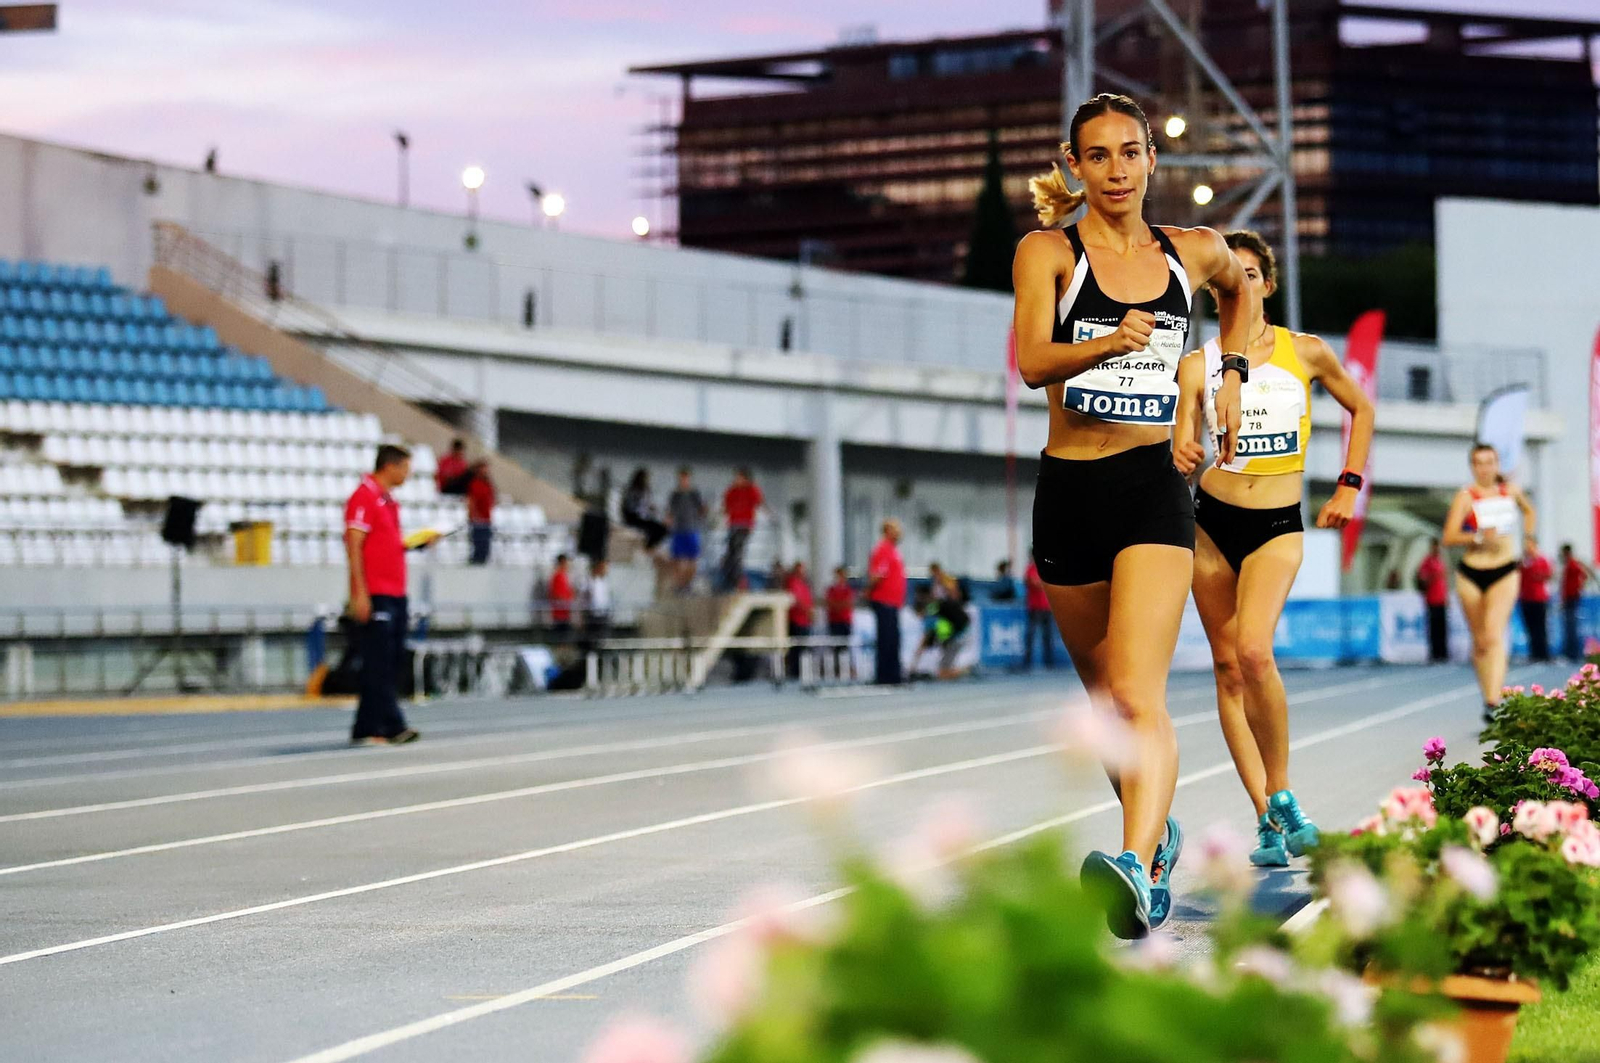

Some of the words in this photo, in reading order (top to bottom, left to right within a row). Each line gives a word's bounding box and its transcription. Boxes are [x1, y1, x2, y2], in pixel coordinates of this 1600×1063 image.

[1091, 360, 1166, 372] ARCÍA-CARO
[1118, 376, 1134, 387] 77
[1249, 422, 1262, 431] 78
[1236, 435, 1288, 453] oma
